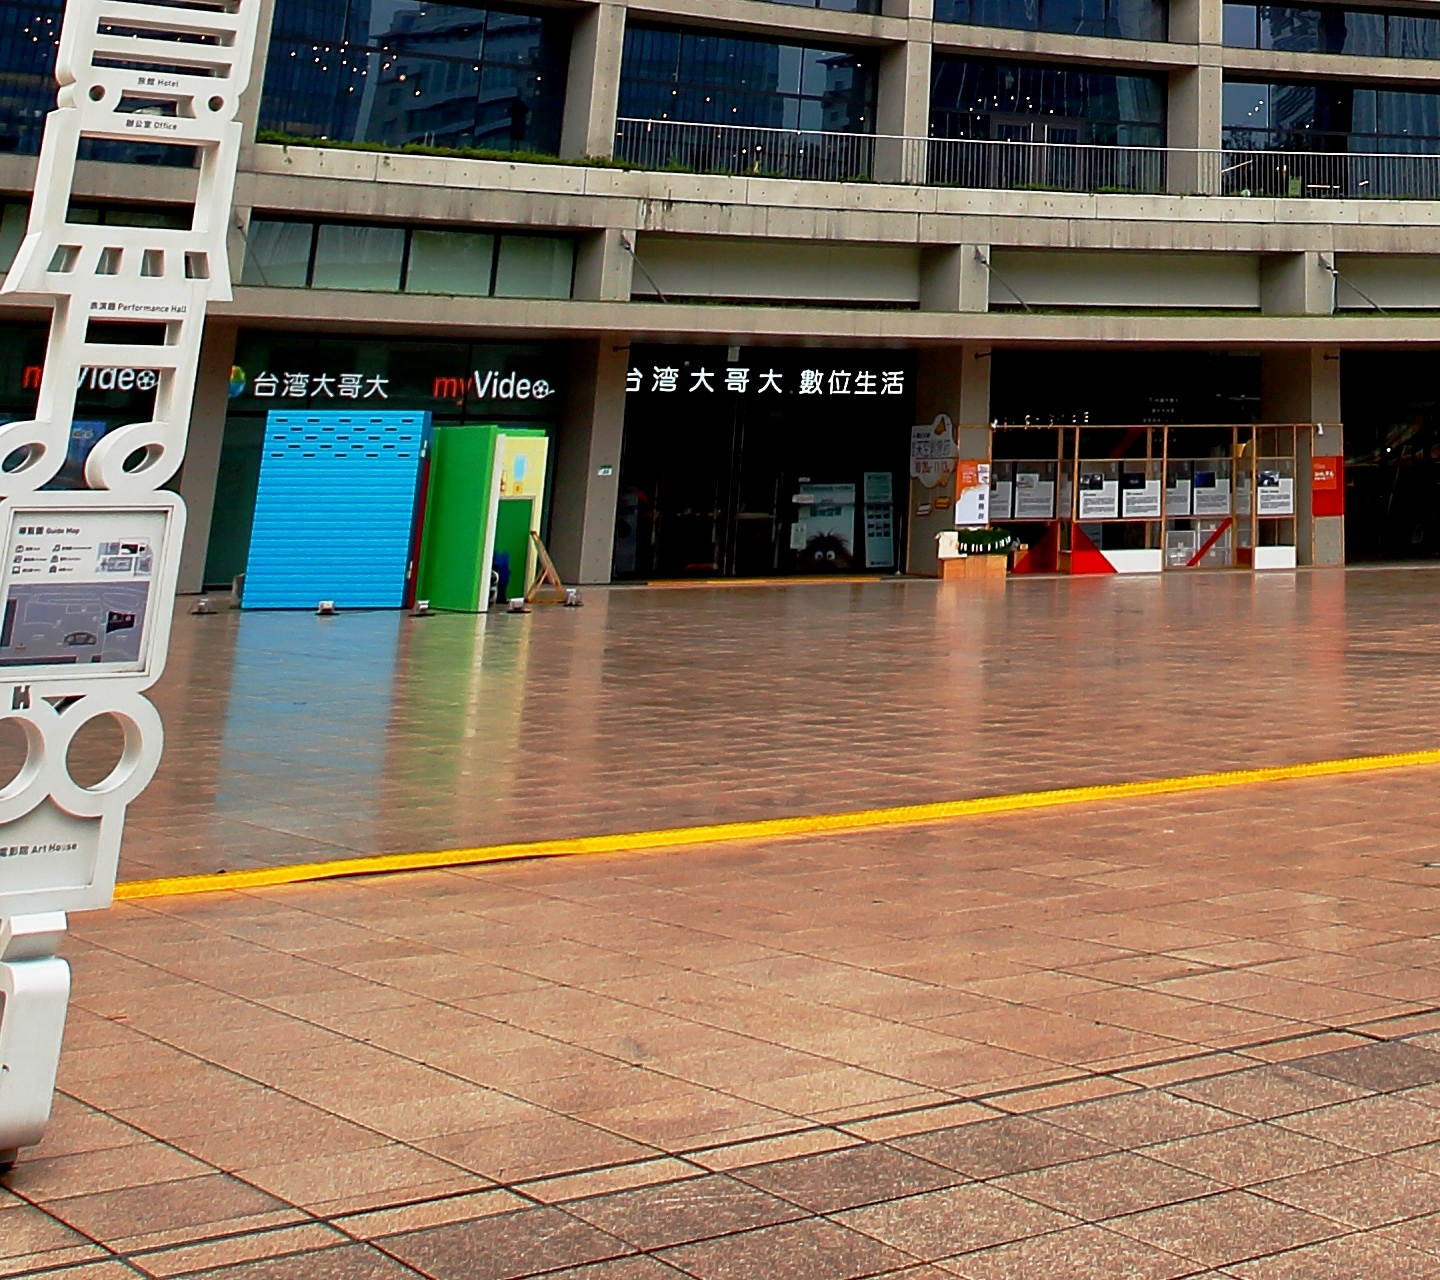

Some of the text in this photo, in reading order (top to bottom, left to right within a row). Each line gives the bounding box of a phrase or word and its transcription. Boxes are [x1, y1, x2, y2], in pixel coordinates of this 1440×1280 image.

[157, 79, 179, 88] Hotel
[153, 121, 178, 130] Office
[117, 303, 169, 313] Performance
[171, 305, 187, 313] Hall
[46, 526, 65, 535] Guide
[66, 526, 81, 535] Map
[31, 843, 47, 854] Art
[47, 842, 78, 852] House
